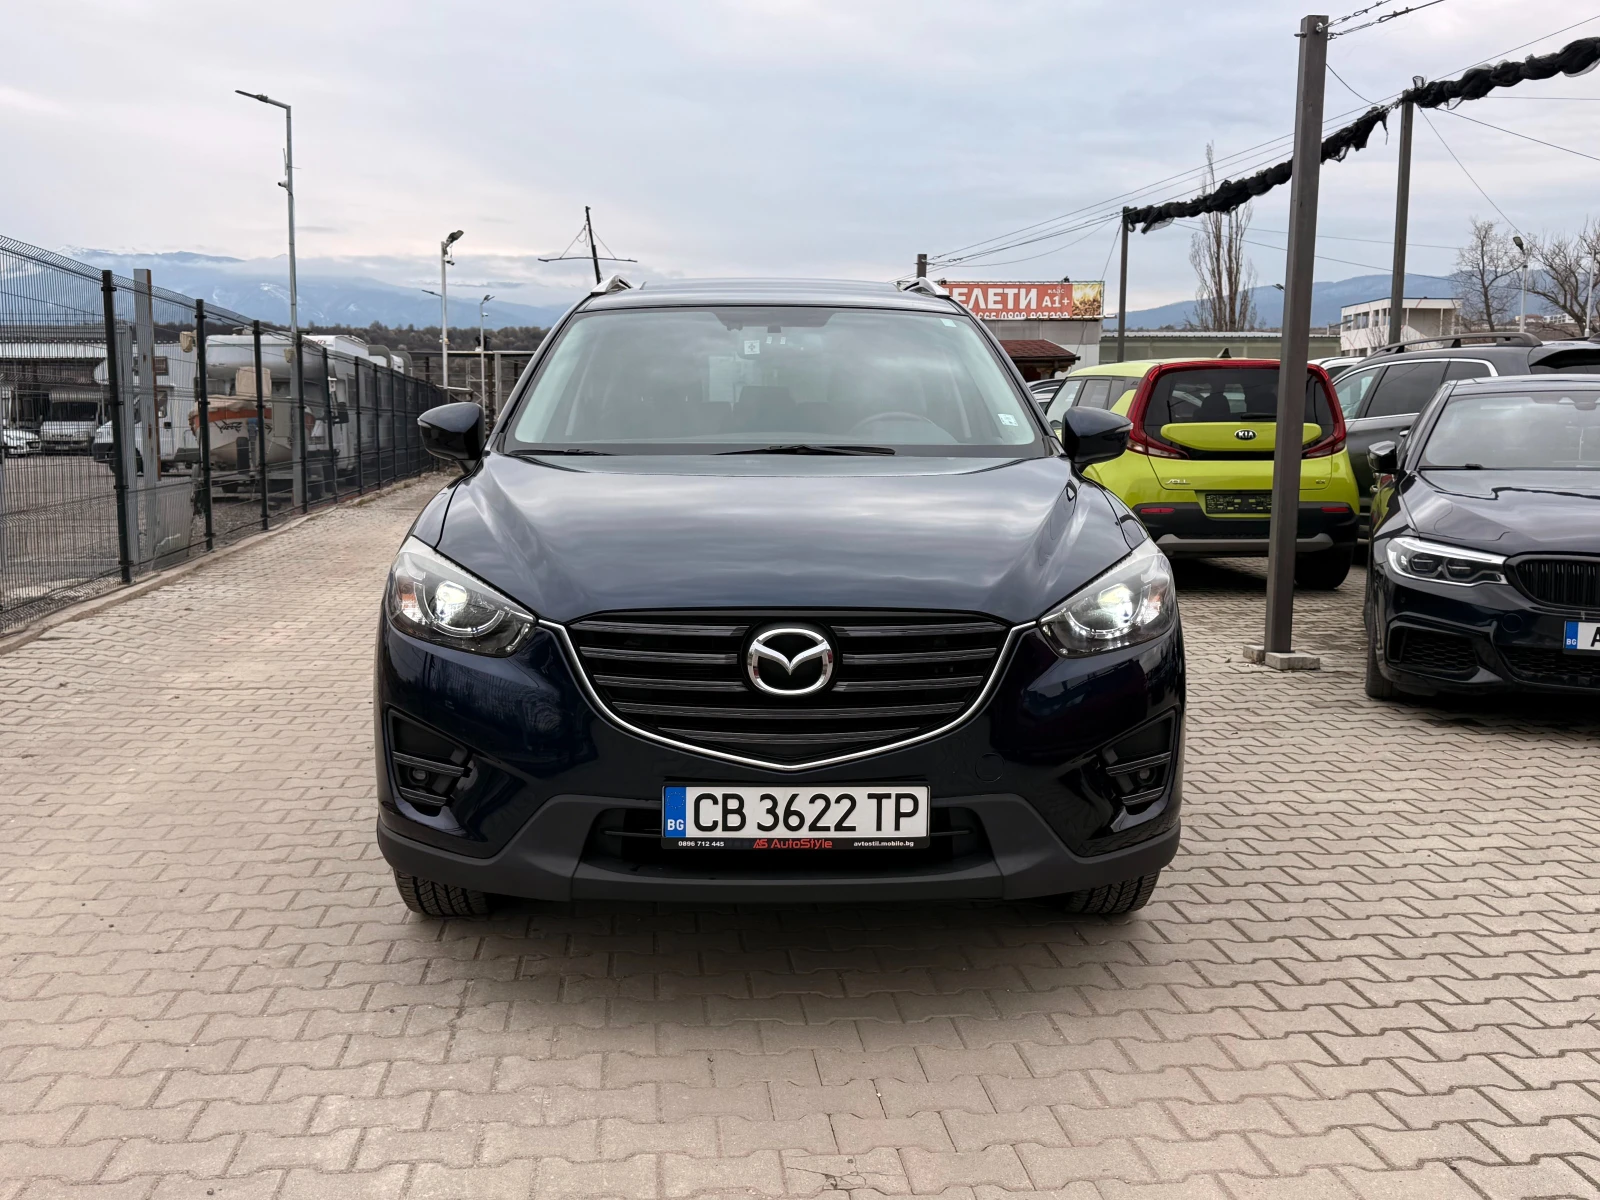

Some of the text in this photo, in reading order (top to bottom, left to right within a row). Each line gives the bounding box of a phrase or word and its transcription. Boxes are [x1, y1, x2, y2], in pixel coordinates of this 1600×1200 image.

[1238, 431, 1254, 439] KIA
[1566, 638, 1577, 646] BG
[693, 792, 920, 832] CB 3622 TP
[667, 818, 685, 831] BG
[771, 838, 832, 850] AutoStyle
[853, 840, 915, 848] avtostil.mobile.bg
